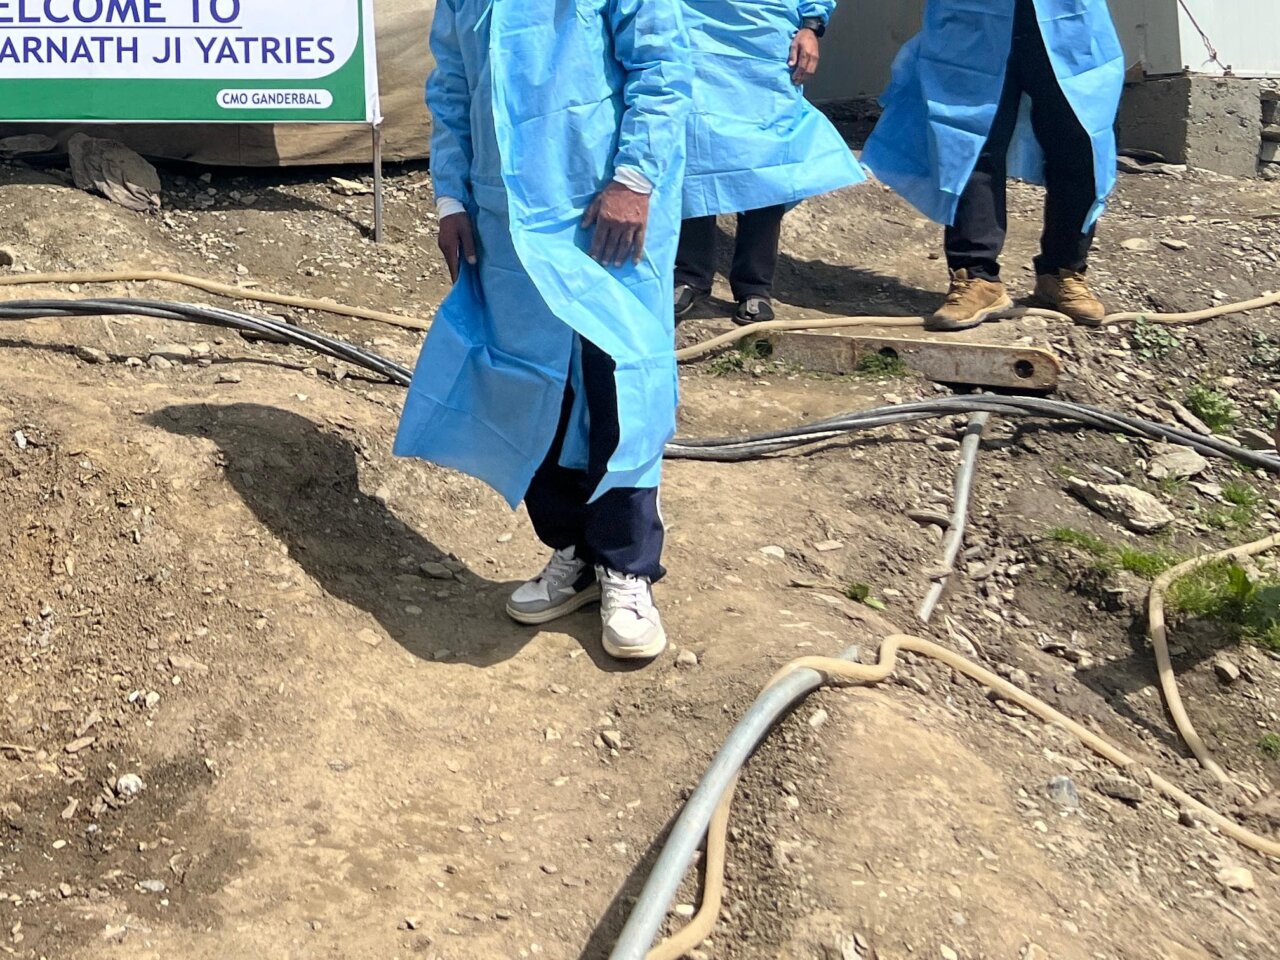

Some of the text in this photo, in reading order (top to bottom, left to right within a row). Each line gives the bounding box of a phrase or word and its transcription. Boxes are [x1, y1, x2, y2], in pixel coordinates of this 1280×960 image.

[152, 37, 181, 64] JI
[195, 37, 335, 64] YATRIES
[222, 93, 321, 105] CMO GANDERBAL
